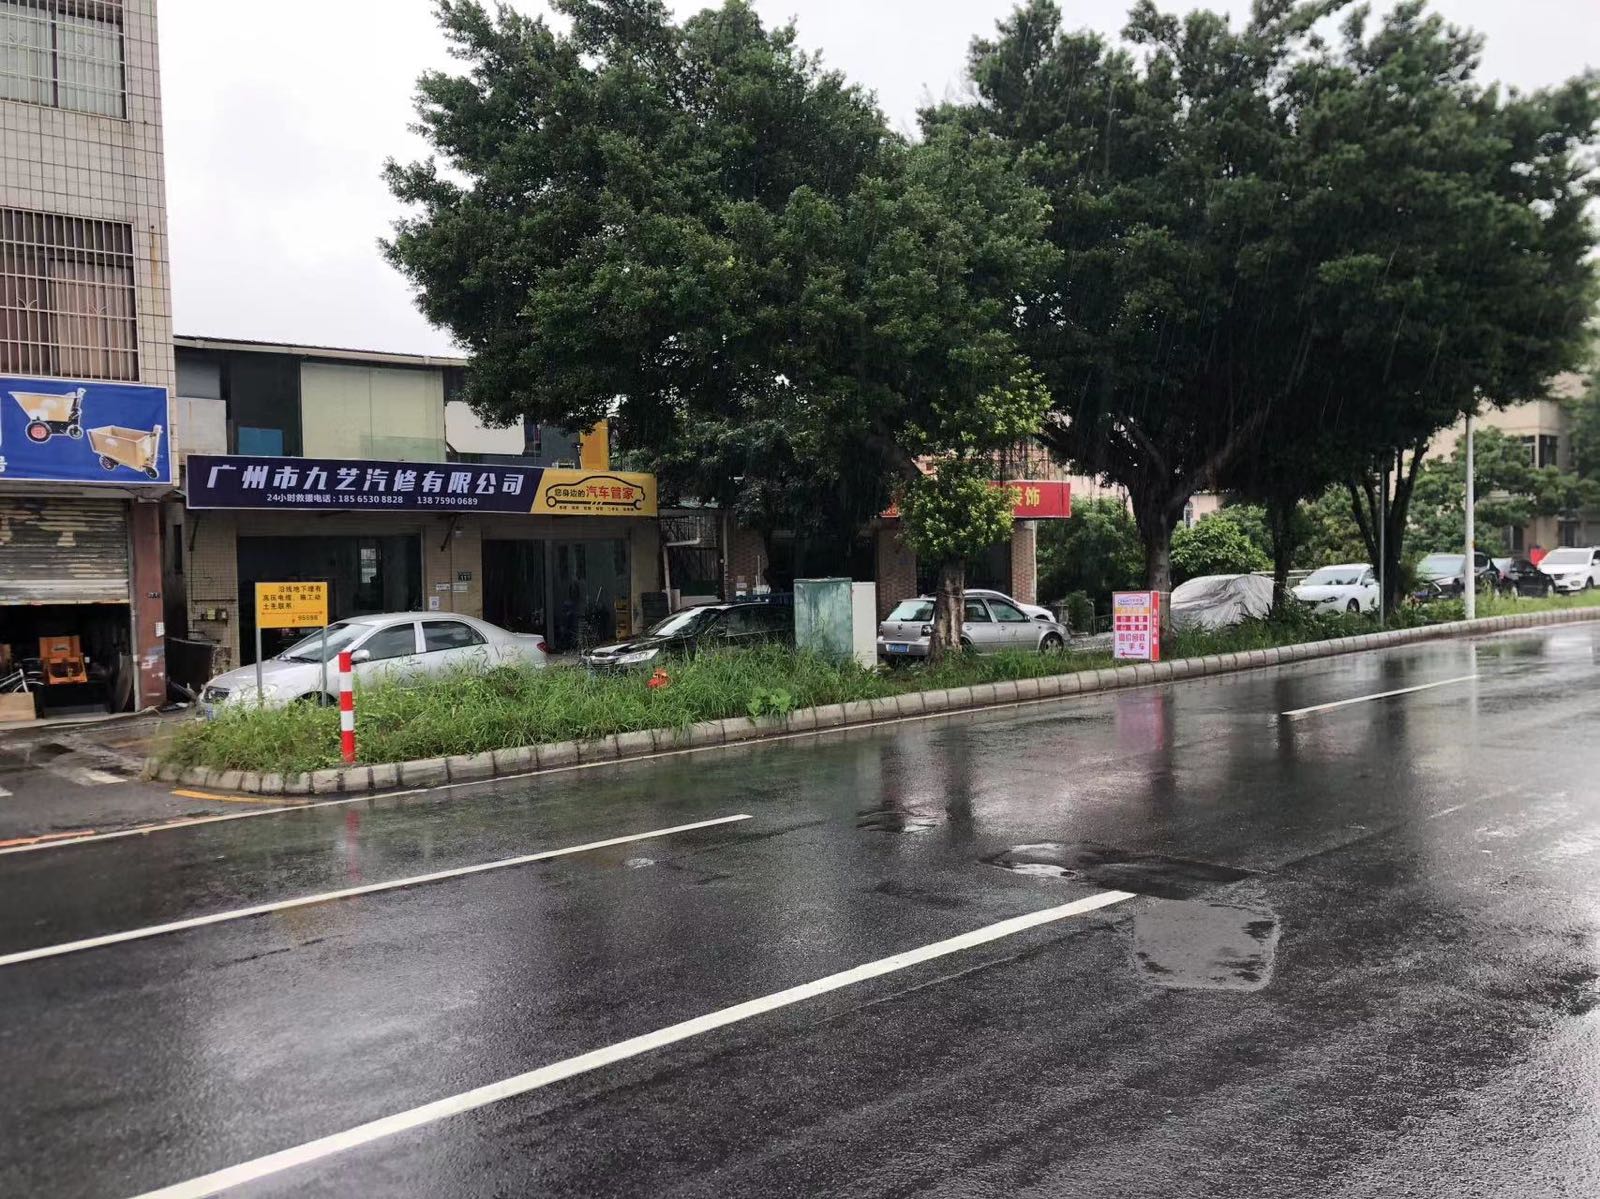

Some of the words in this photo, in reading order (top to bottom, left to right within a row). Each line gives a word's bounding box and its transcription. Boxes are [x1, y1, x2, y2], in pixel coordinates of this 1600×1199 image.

[206, 464, 524, 496] 广州市九艺汽修有限公司
[338, 494, 355, 503] 185
[357, 495, 380, 504] 6530
[381, 495, 404, 504] 8828
[416, 496, 433, 505] 138
[435, 496, 456, 505] 7590
[457, 497, 478, 506] 0689
